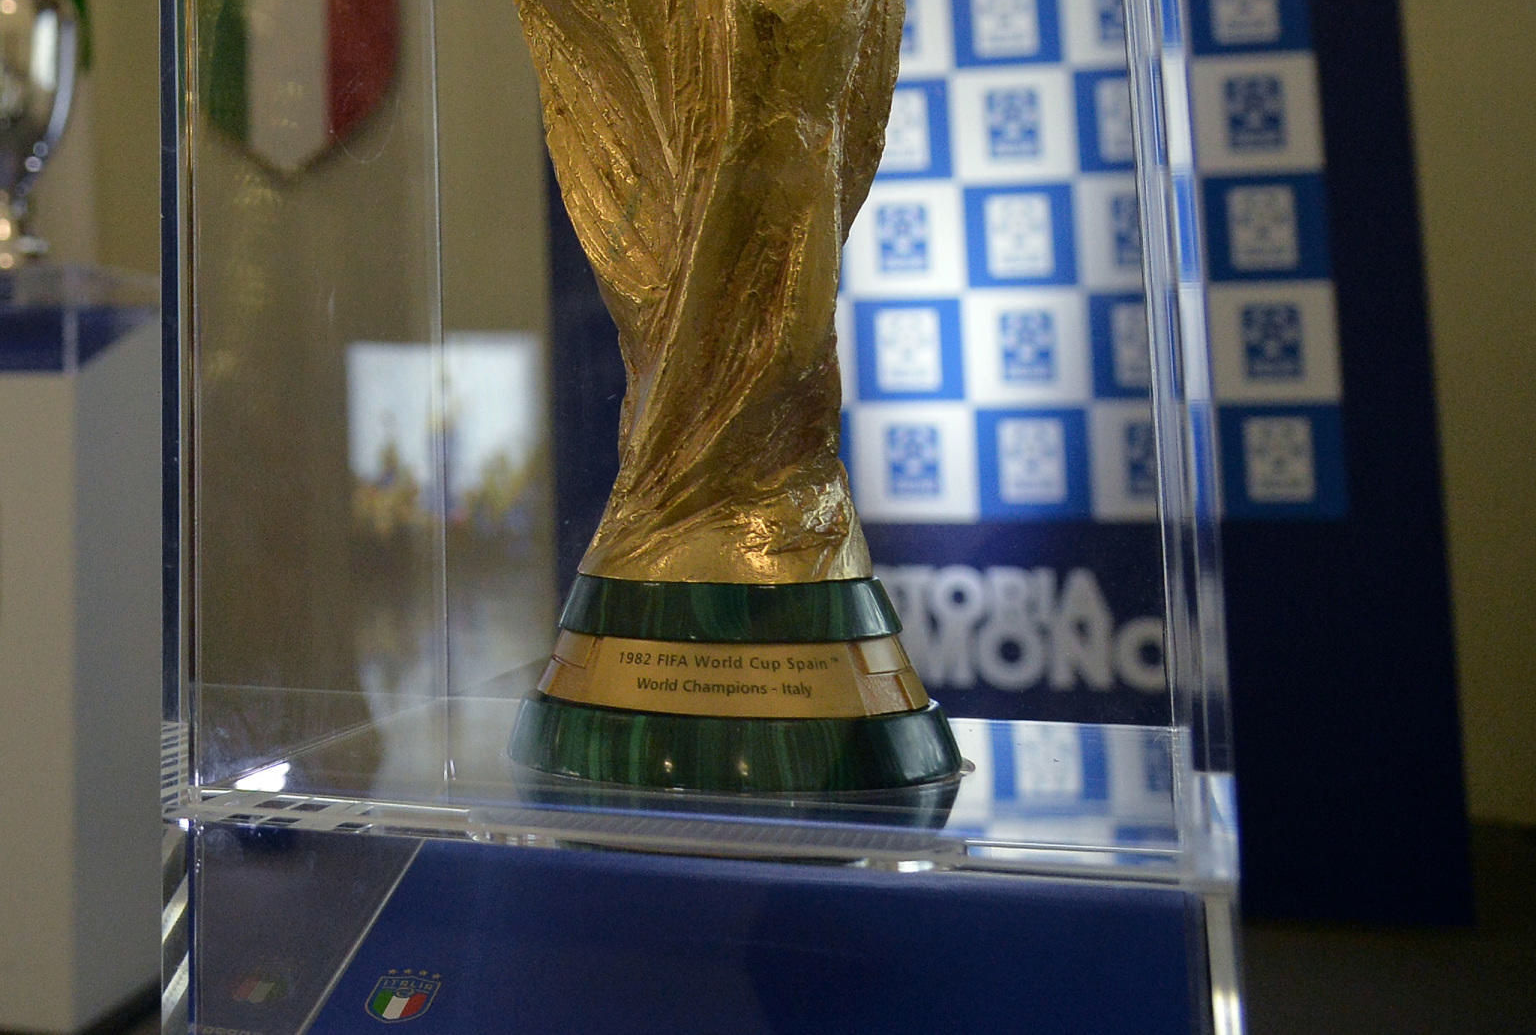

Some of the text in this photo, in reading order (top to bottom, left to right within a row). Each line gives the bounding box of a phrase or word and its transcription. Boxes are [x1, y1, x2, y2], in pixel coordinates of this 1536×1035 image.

[619, 651, 652, 666] 1982
[656, 653, 689, 668] FIFA
[694, 655, 743, 670] World
[749, 656, 781, 672] Cup
[637, 677, 678, 692] World
[682, 679, 768, 697] Champions
[781, 681, 813, 698] Italy
